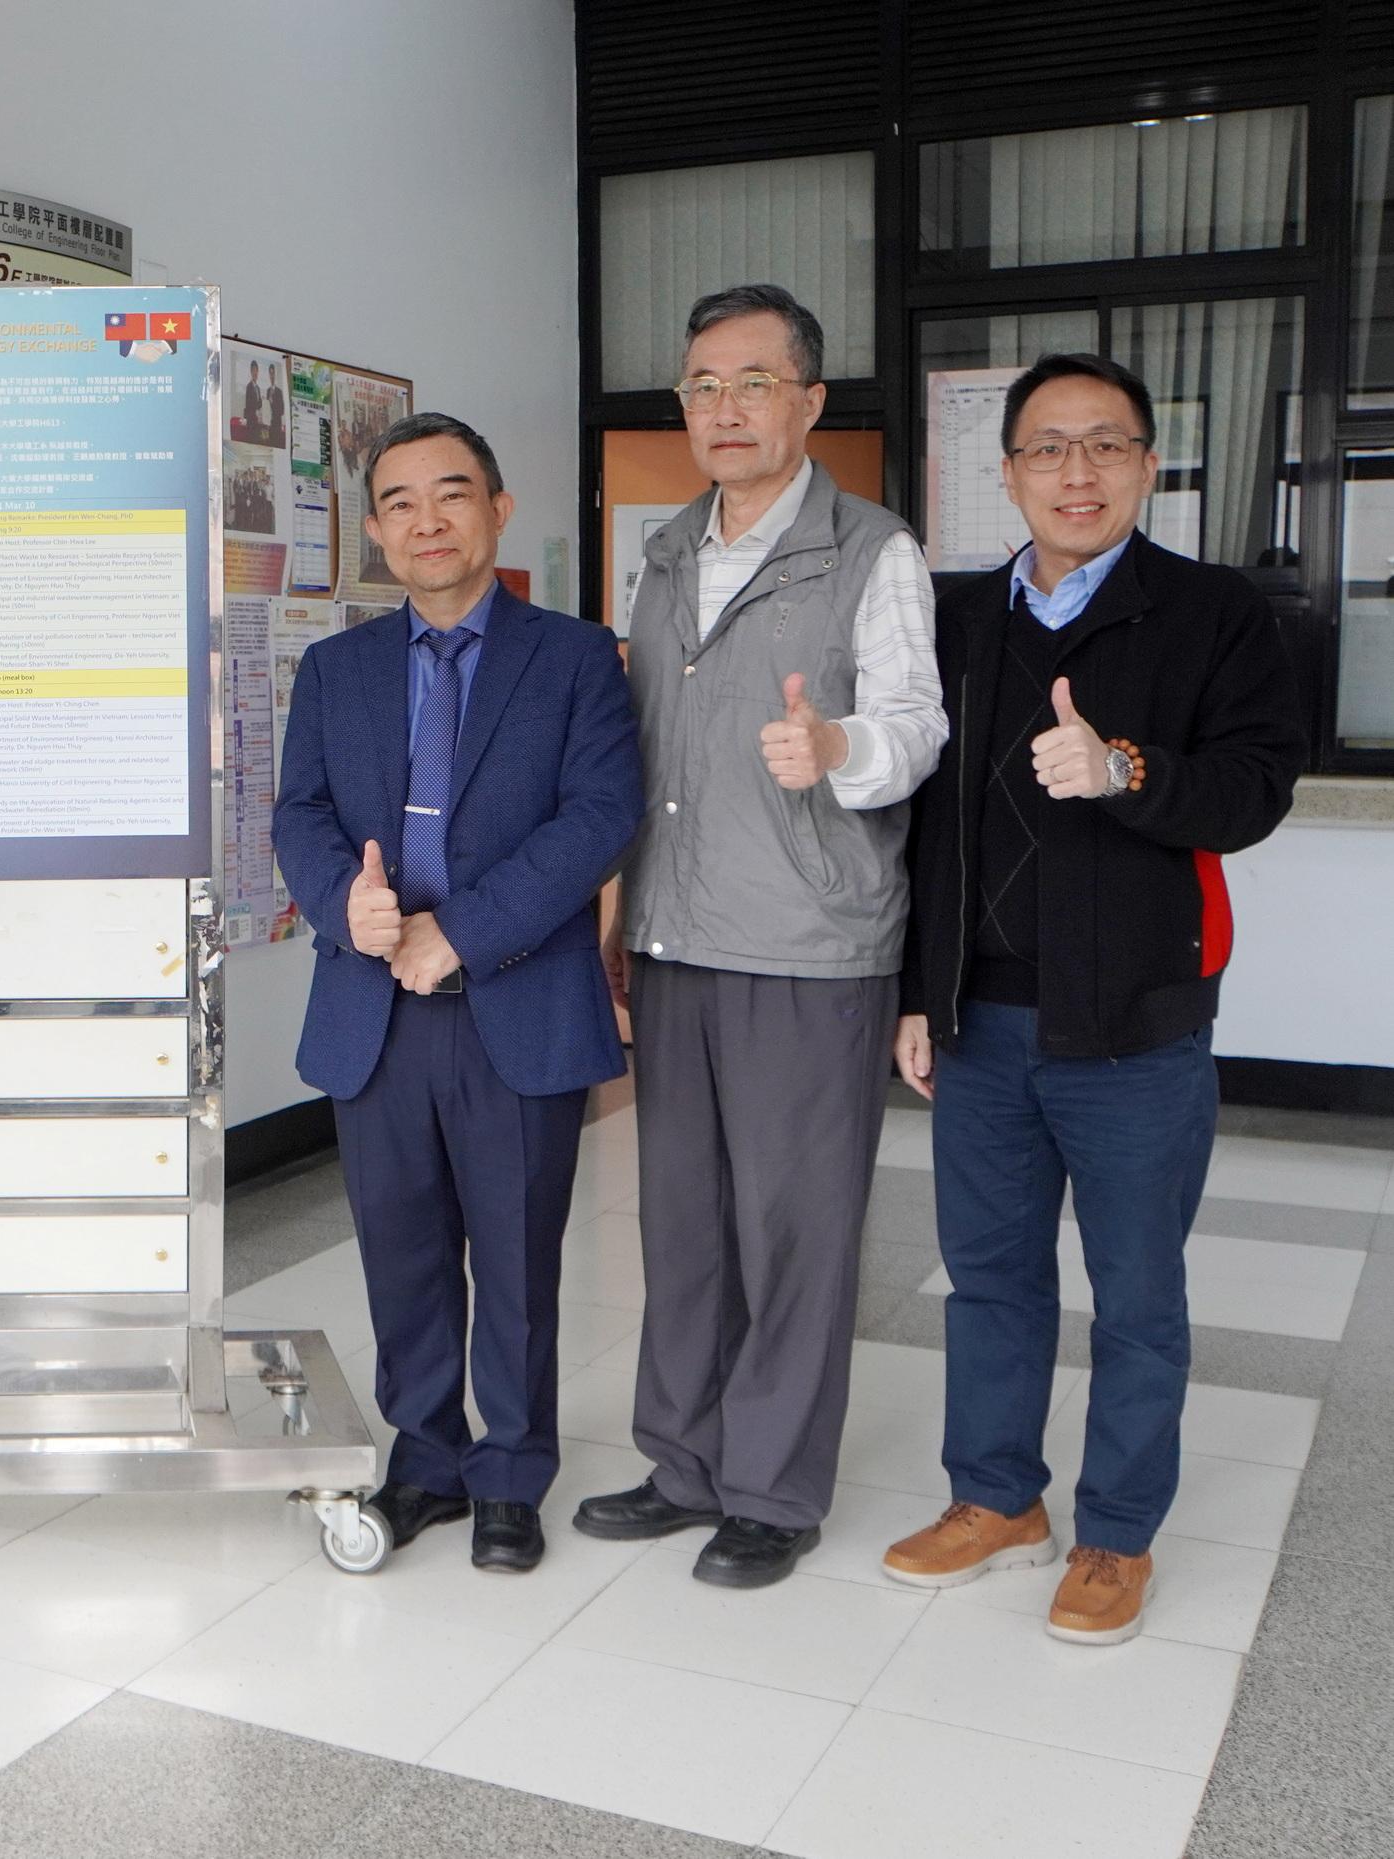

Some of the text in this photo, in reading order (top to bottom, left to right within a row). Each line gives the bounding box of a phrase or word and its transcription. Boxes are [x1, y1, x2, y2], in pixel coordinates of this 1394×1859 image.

[2, 222, 32, 239] College
[36, 230, 44, 240] of
[49, 232, 88, 255] Engineering
[91, 244, 105, 257] Floor
[18, 338, 98, 353] EXCHANGE
[2, 674, 20, 682] (meal
[20, 673, 35, 682] box)
